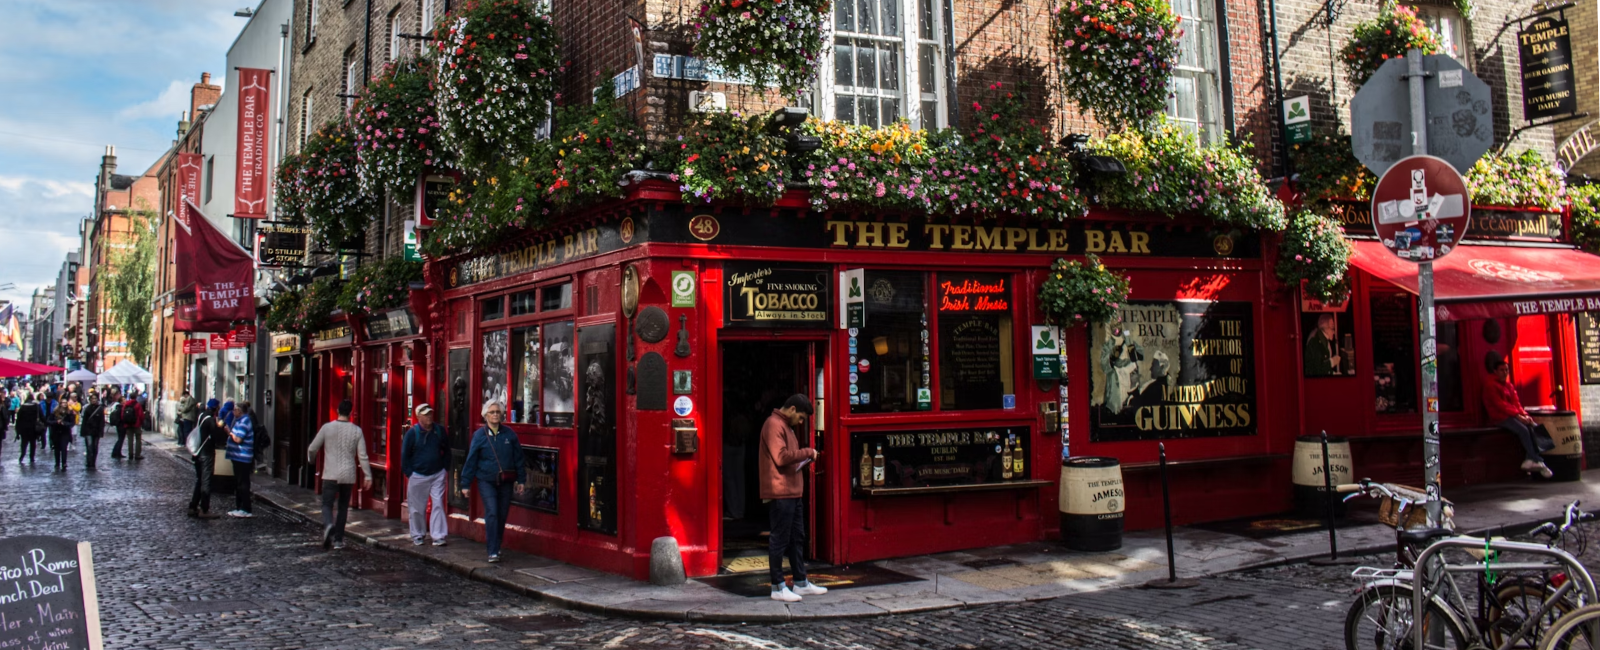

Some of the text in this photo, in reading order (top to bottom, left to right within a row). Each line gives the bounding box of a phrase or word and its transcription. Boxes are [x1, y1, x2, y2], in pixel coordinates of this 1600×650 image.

[1534, 21, 1550, 31] THE
[1520, 26, 1568, 45] TEMPLE
[1532, 41, 1557, 55] BAR
[1524, 64, 1569, 79] BEER GARDEN
[1528, 90, 1570, 104] LIVE MUSIC
[1538, 101, 1560, 110] DAILY
[242, 95, 254, 193] THE TEMPLE BAR
[1560, 126, 1596, 166] THE
[255, 129, 264, 177] TRADING
[623, 222, 632, 238] 48
[694, 219, 713, 234] 48
[826, 220, 1151, 254] THE TEMPLE BAR
[472, 228, 599, 282] THE TEMPLE BAR
[728, 268, 772, 287] Importers
[200, 287, 250, 300] TEMPLE
[214, 282, 235, 290] THE
[767, 283, 817, 291] FINE SMOKING
[941, 279, 1004, 295] Traditional
[213, 299, 239, 309] BAR
[740, 286, 818, 316] TOBACCO
[940, 296, 1008, 311] Irish Music
[1513, 298, 1600, 314] THE TEMPLE BA
[756, 311, 782, 320] Always
[800, 311, 824, 319] Stock
[1121, 310, 1178, 323] TEMPLE
[954, 320, 998, 335] TEMPLE BAR
[1138, 324, 1165, 337] BAR
[1219, 320, 1242, 336] THE
[1192, 339, 1242, 356] EMPEROR
[1230, 358, 1242, 374] OF
[1161, 376, 1248, 403] MALTED LIQUORS
[1135, 403, 1250, 431] GUINNESS
[887, 433, 915, 447] THE
[918, 432, 970, 446] TEMPLE
[931, 446, 958, 455] DUBLIN
[1312, 464, 1349, 475] JAESON
[1092, 488, 1123, 502] JAMESO
[28, 548, 78, 575] Rome
[0, 575, 64, 604] nch Deal
[37, 602, 78, 626] Main
[0, 628, 74, 648] ass of wine
